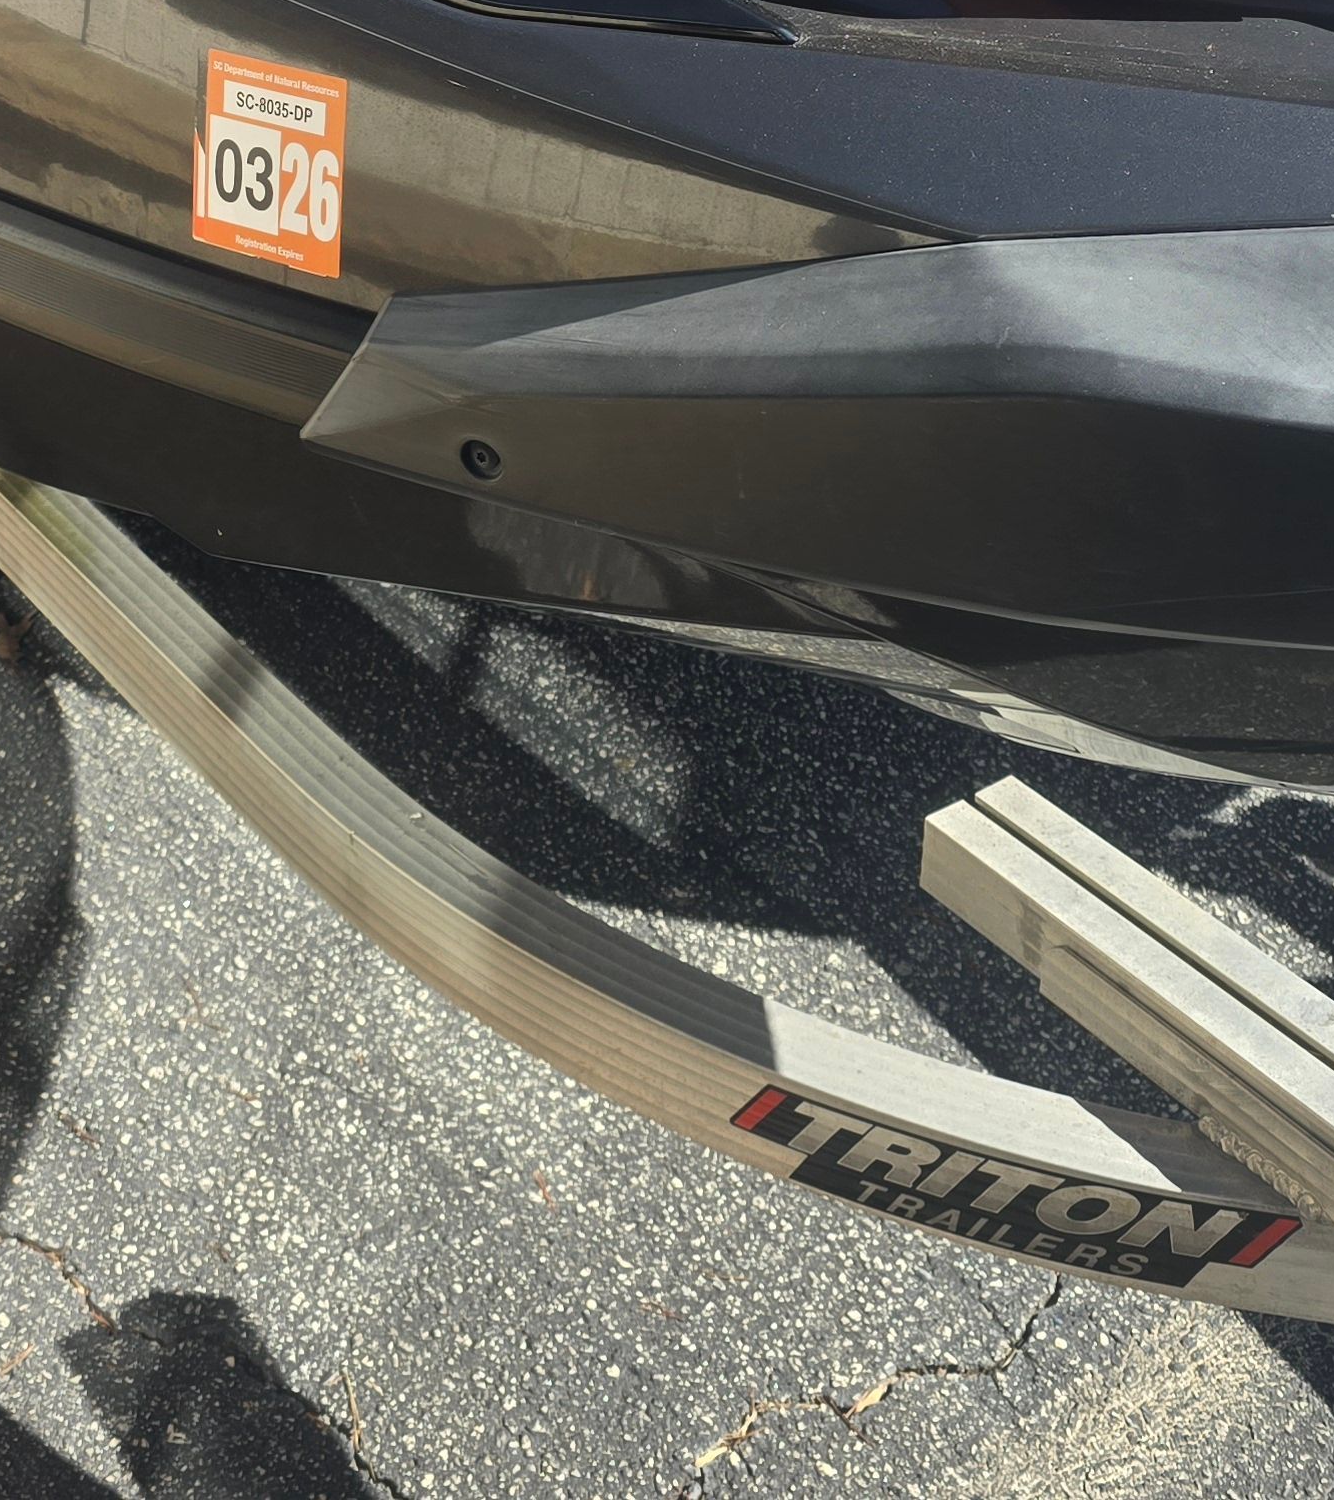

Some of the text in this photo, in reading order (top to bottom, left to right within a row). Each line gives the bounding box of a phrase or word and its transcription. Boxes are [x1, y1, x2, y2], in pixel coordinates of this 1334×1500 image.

[213, 61, 339, 98] SC Department of Natural Resources
[236, 91, 313, 123] SC-8035-DP
[215, 138, 340, 243] 03 26
[235, 234, 304, 262] Registration Expires
[788, 1101, 1247, 1258] TRITON
[858, 1180, 1151, 1277] TRAILERS
